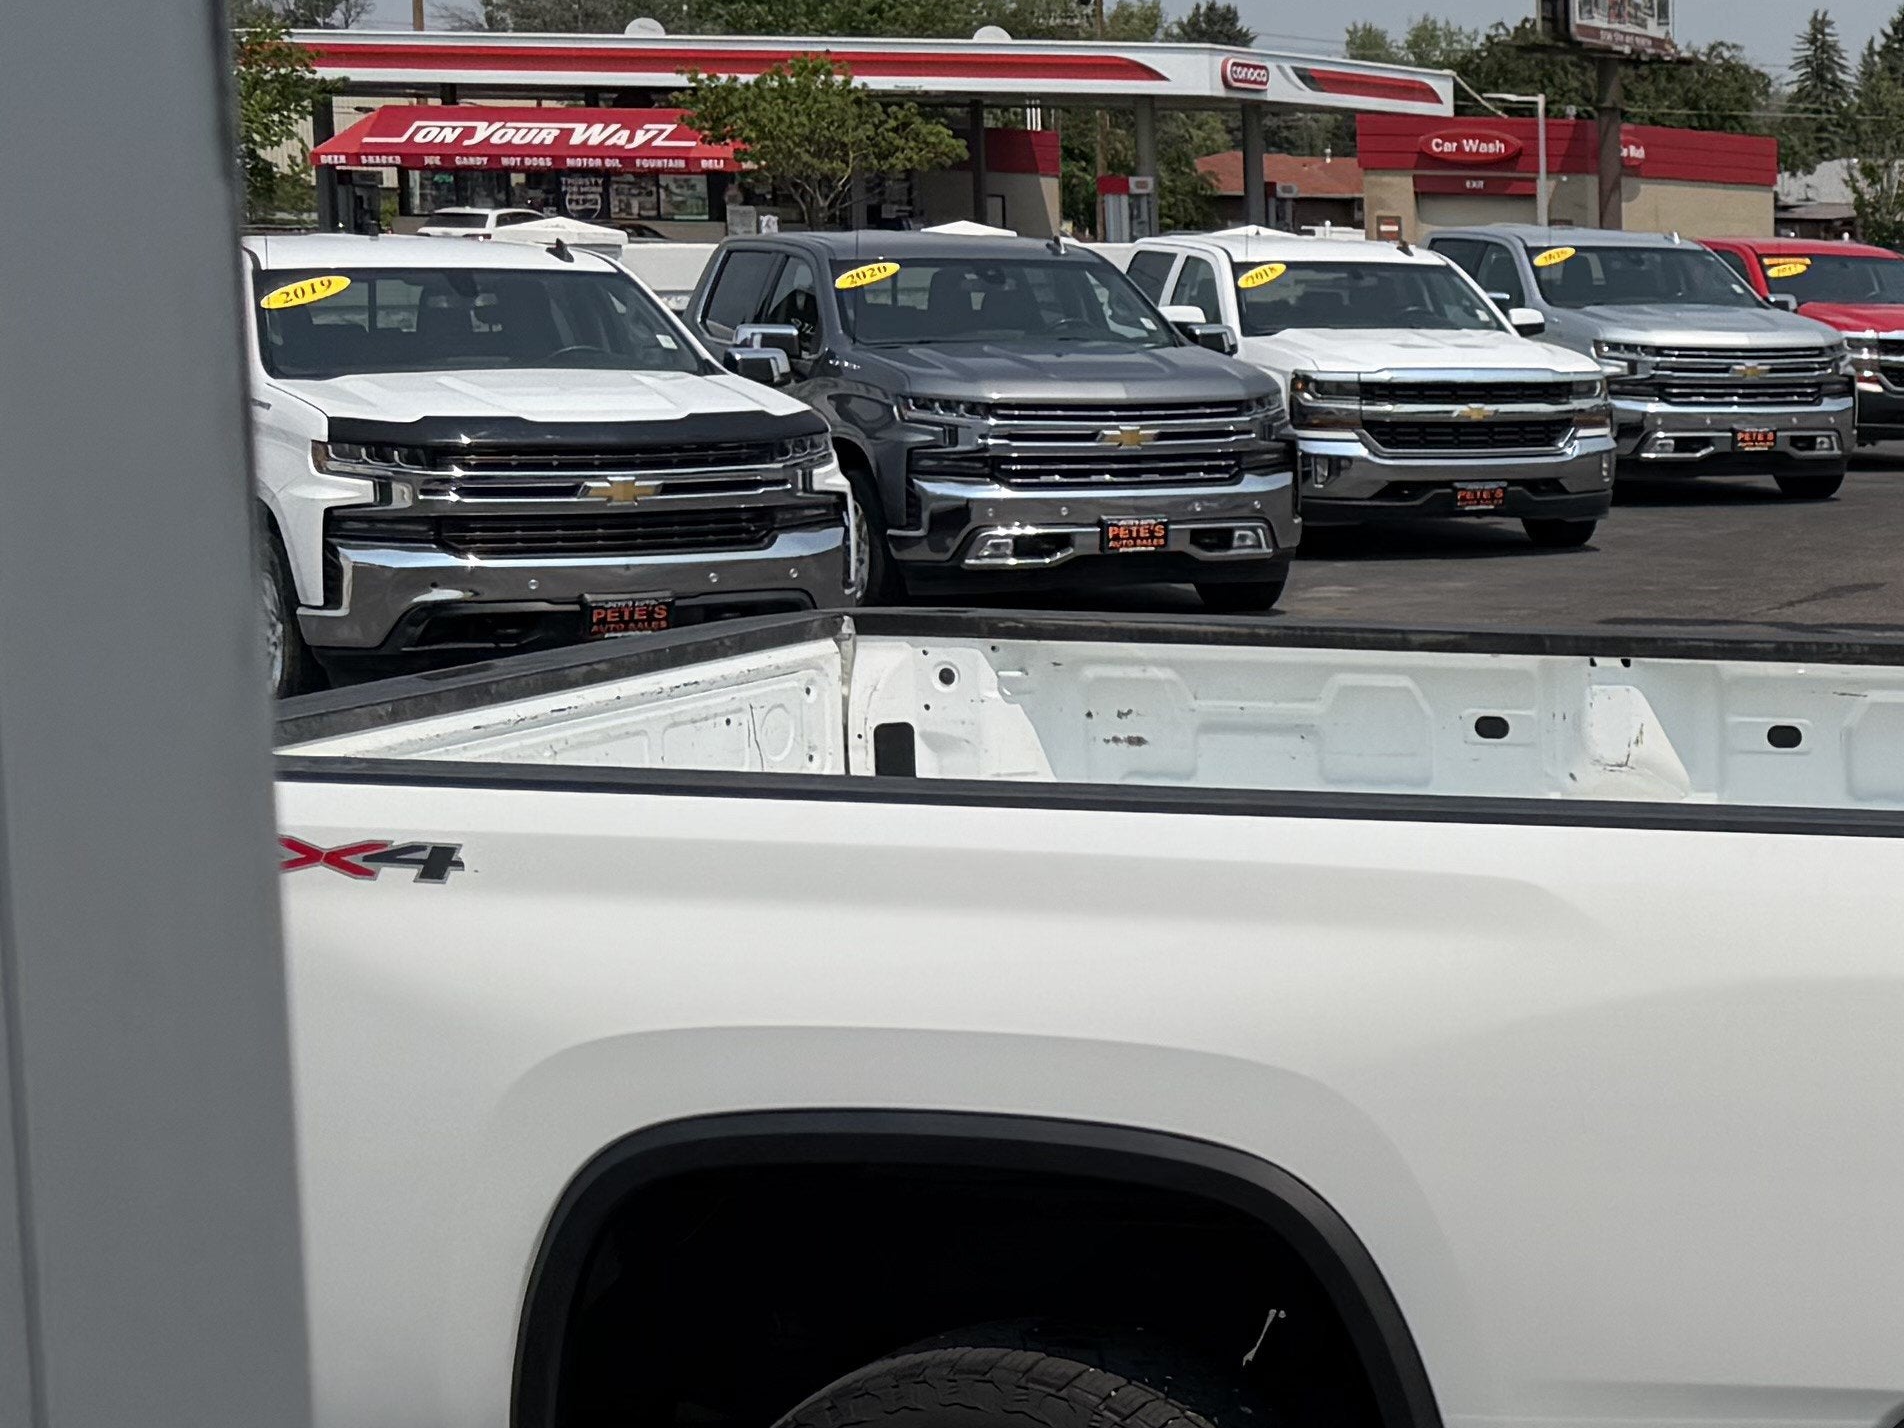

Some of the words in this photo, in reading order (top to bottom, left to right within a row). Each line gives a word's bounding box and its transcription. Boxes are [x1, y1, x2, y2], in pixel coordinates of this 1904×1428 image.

[413, 126, 464, 144] ON
[1431, 138, 1458, 153] Car
[1462, 139, 1505, 154] Wash
[455, 156, 489, 166] CANDY
[501, 156, 522, 166] HOT
[524, 157, 552, 167] DOGS
[566, 157, 602, 168] MOTOR
[635, 158, 686, 169] FOUNTAIN
[701, 159, 724, 169] DELI
[280, 278, 333, 304] 2019
[1108, 524, 1165, 539] PETE'S
[592, 604, 668, 624] PETE'S
[628, 620, 668, 632] SALES
